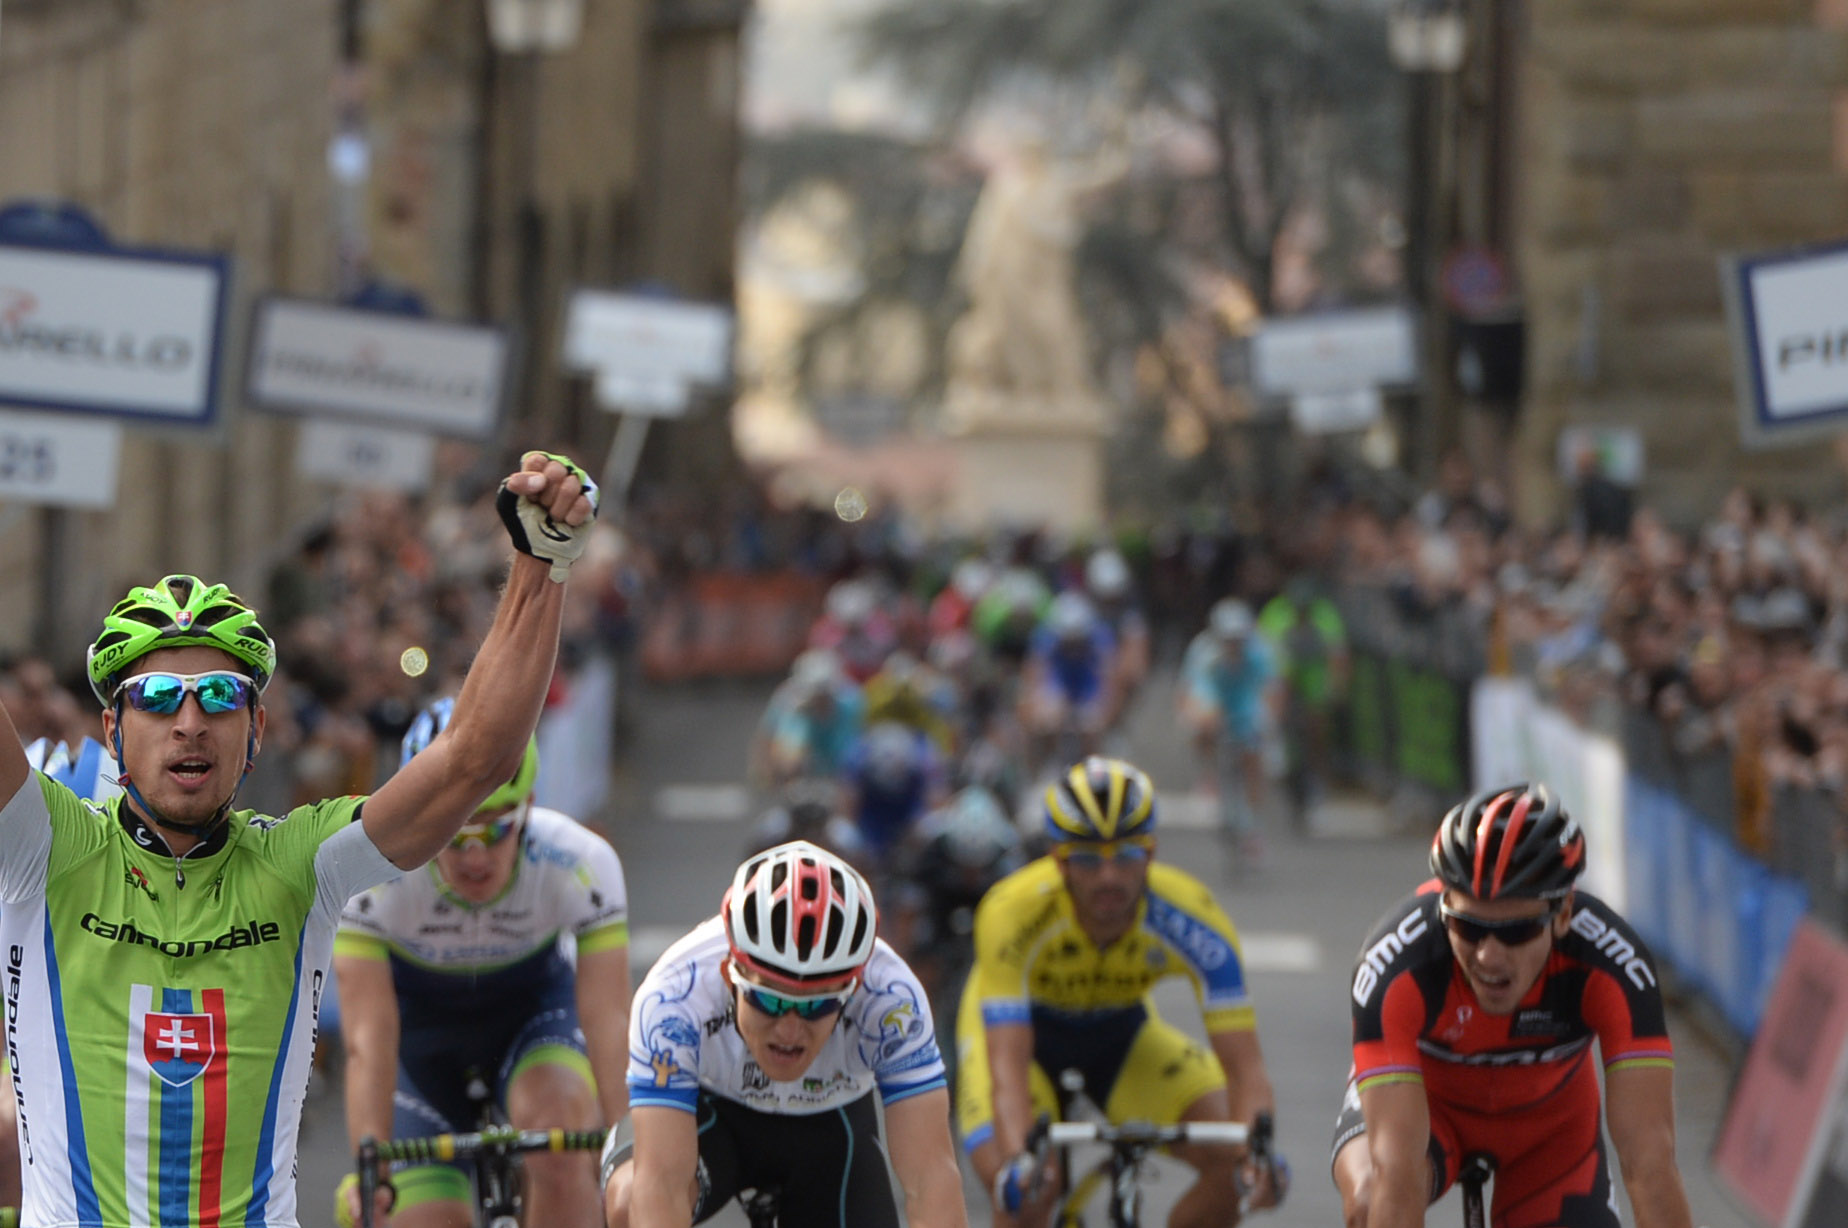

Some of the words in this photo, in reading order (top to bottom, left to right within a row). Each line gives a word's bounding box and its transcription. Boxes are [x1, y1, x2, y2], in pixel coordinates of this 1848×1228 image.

[79, 911, 281, 959] cannondale
[1352, 907, 1429, 1009] BMC
[1569, 907, 1657, 992] BMC
[7, 943, 34, 1167] cannondale
